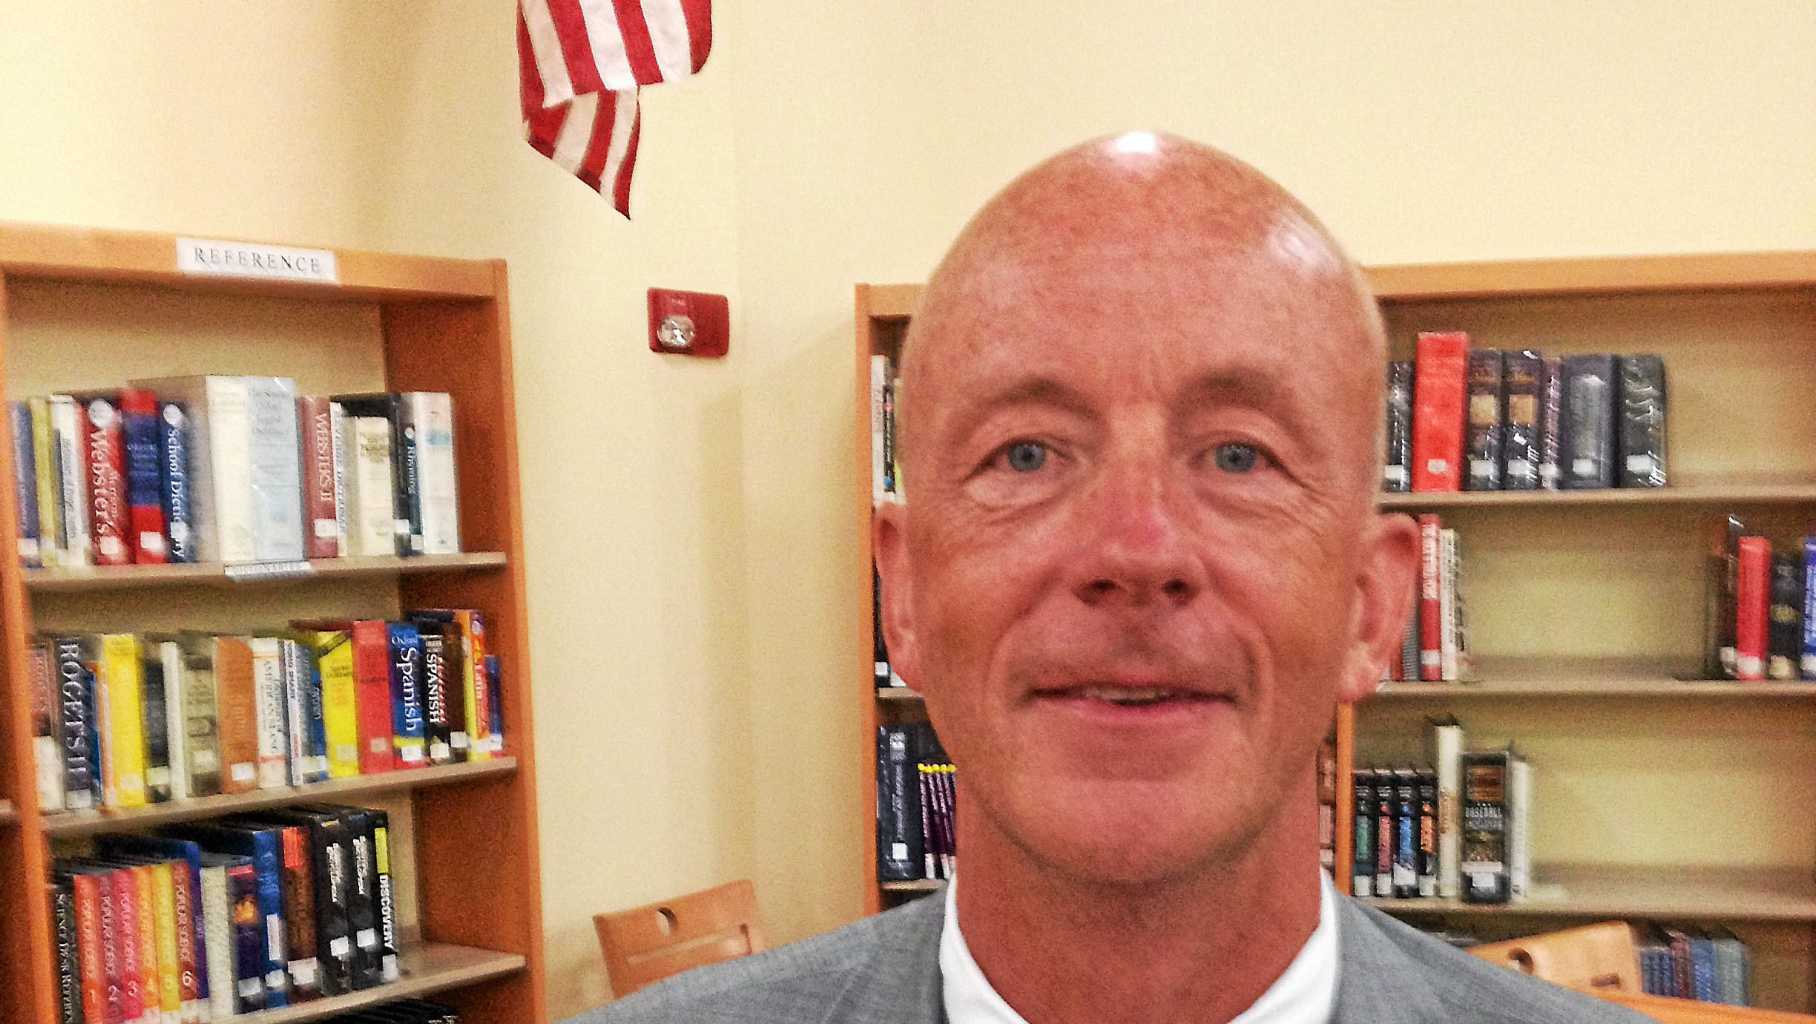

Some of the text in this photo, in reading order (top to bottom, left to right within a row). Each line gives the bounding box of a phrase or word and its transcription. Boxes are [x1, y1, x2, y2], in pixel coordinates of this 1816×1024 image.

[193, 247, 321, 274] REFERENCE
[90, 430, 112, 534] Webster's
[167, 428, 186, 558] School Dictiry
[396, 647, 423, 732] Spanish
[426, 653, 440, 723] SPANISH
[379, 874, 394, 949] DISCOVERY
[107, 985, 119, 1001] 2
[127, 980, 138, 997] 3
[181, 970, 193, 986] 6
